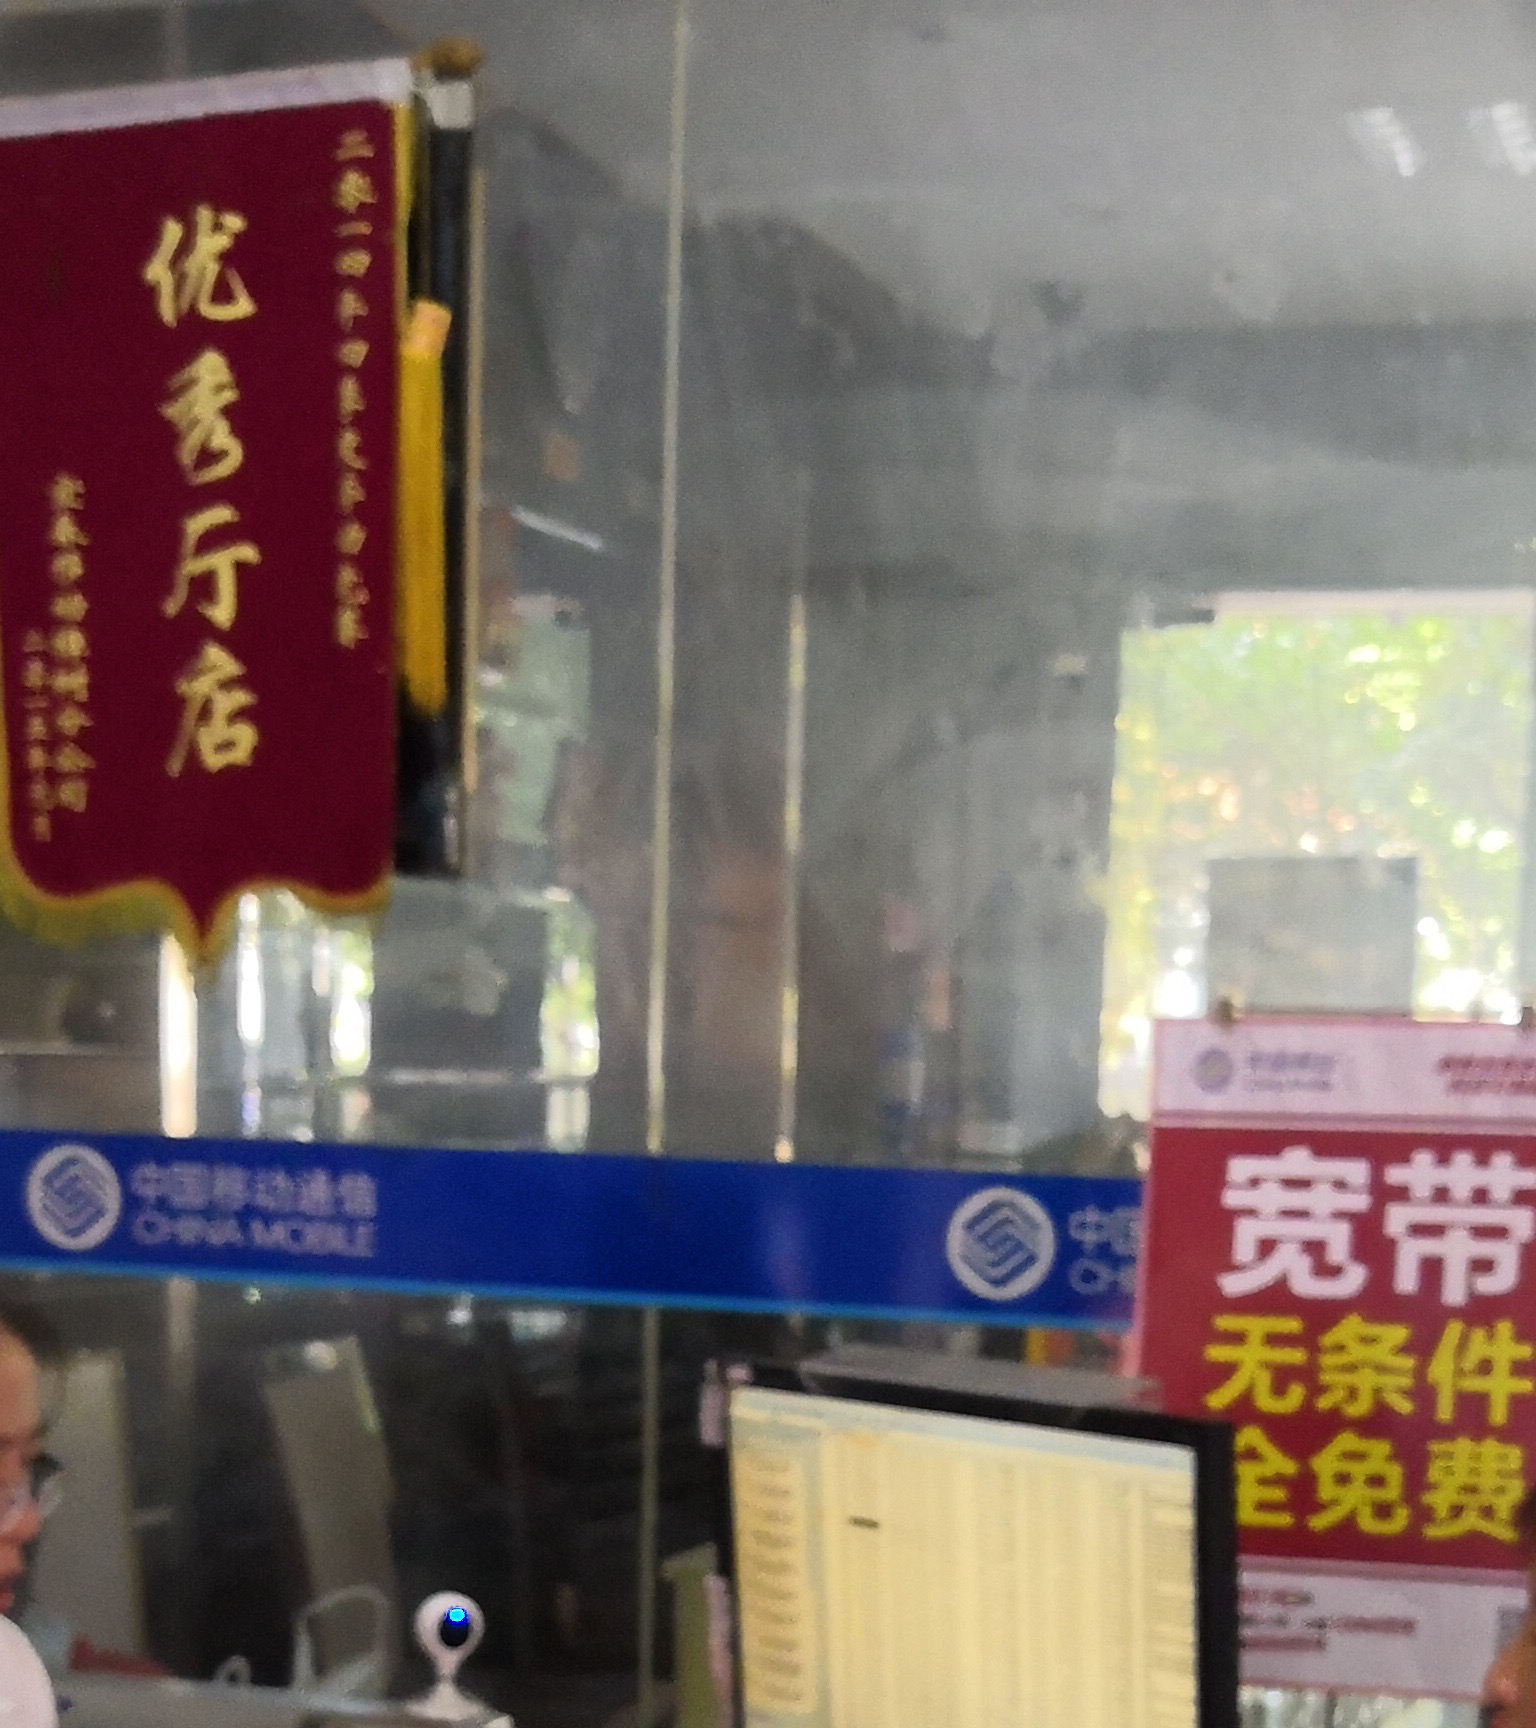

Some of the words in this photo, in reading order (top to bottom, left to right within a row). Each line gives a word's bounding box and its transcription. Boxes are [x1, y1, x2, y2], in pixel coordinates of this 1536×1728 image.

[144, 204, 260, 778] 优秀厅店
[1204, 1313, 1536, 1430] 无条件
